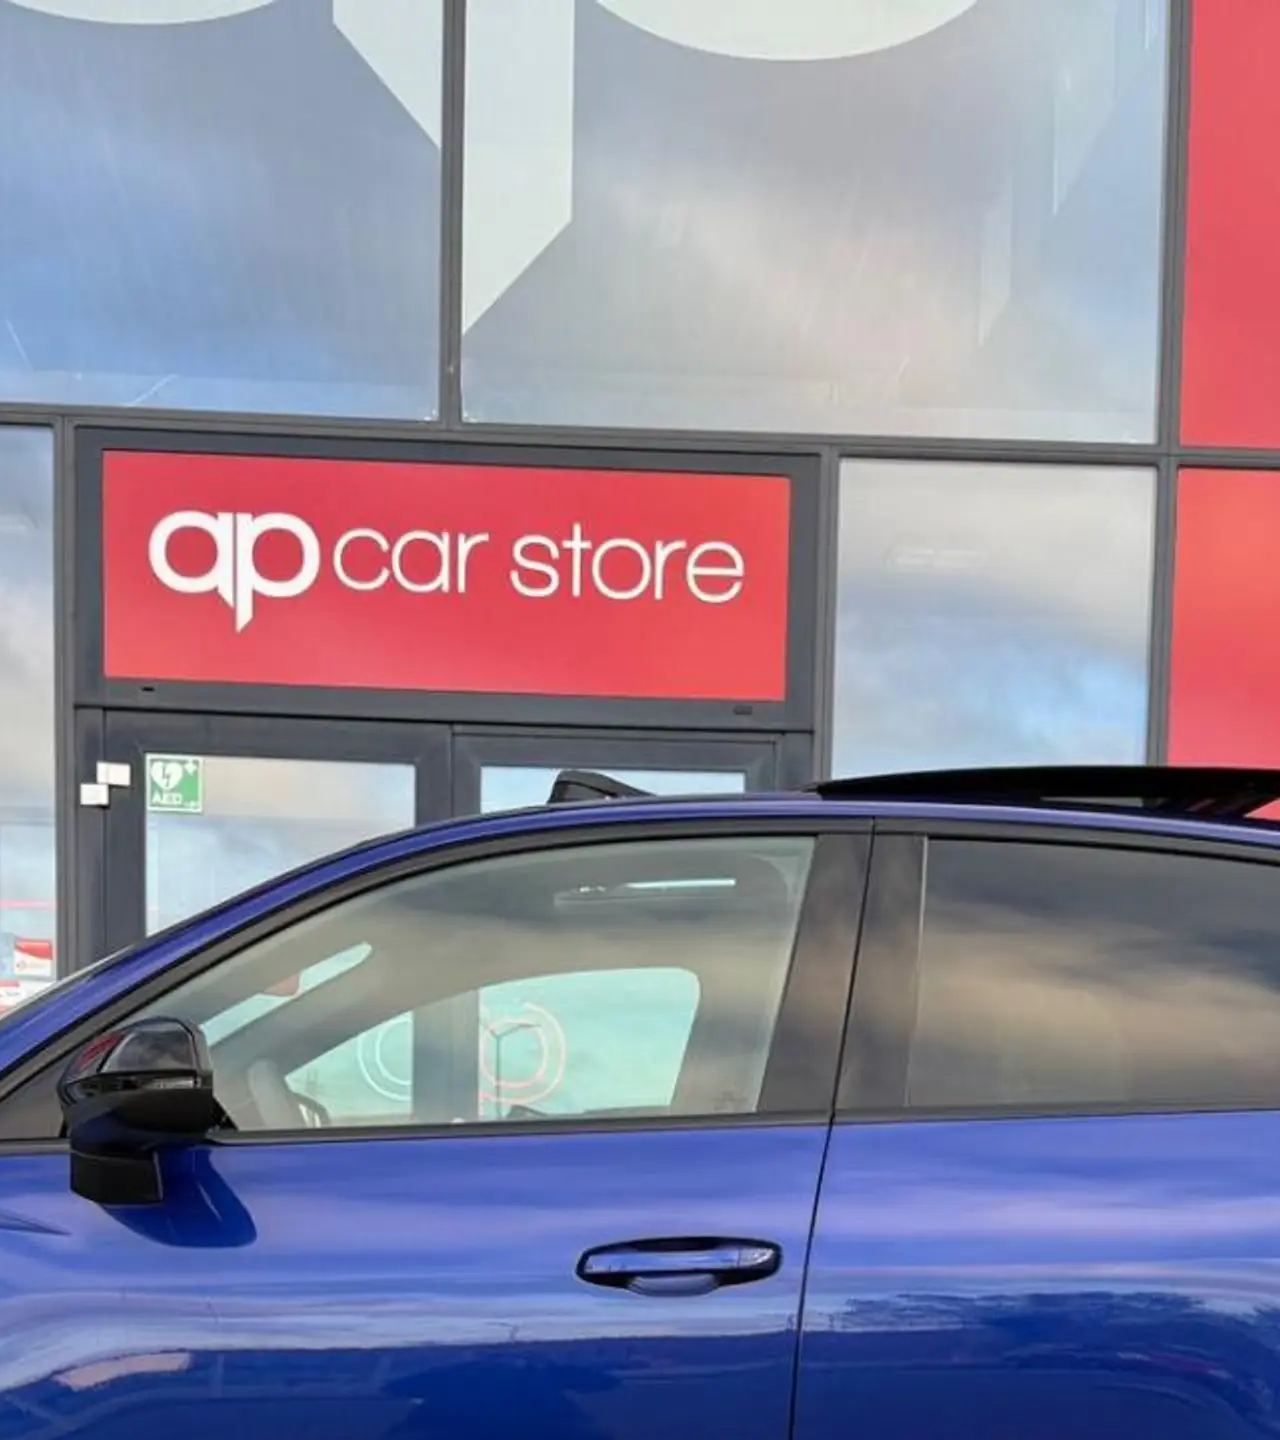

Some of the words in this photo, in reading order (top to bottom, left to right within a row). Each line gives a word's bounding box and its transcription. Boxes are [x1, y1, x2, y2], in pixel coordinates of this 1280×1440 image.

[148, 510, 320, 633] ap
[333, 528, 489, 593] car
[510, 523, 745, 603] store
[152, 790, 183, 805] AED
